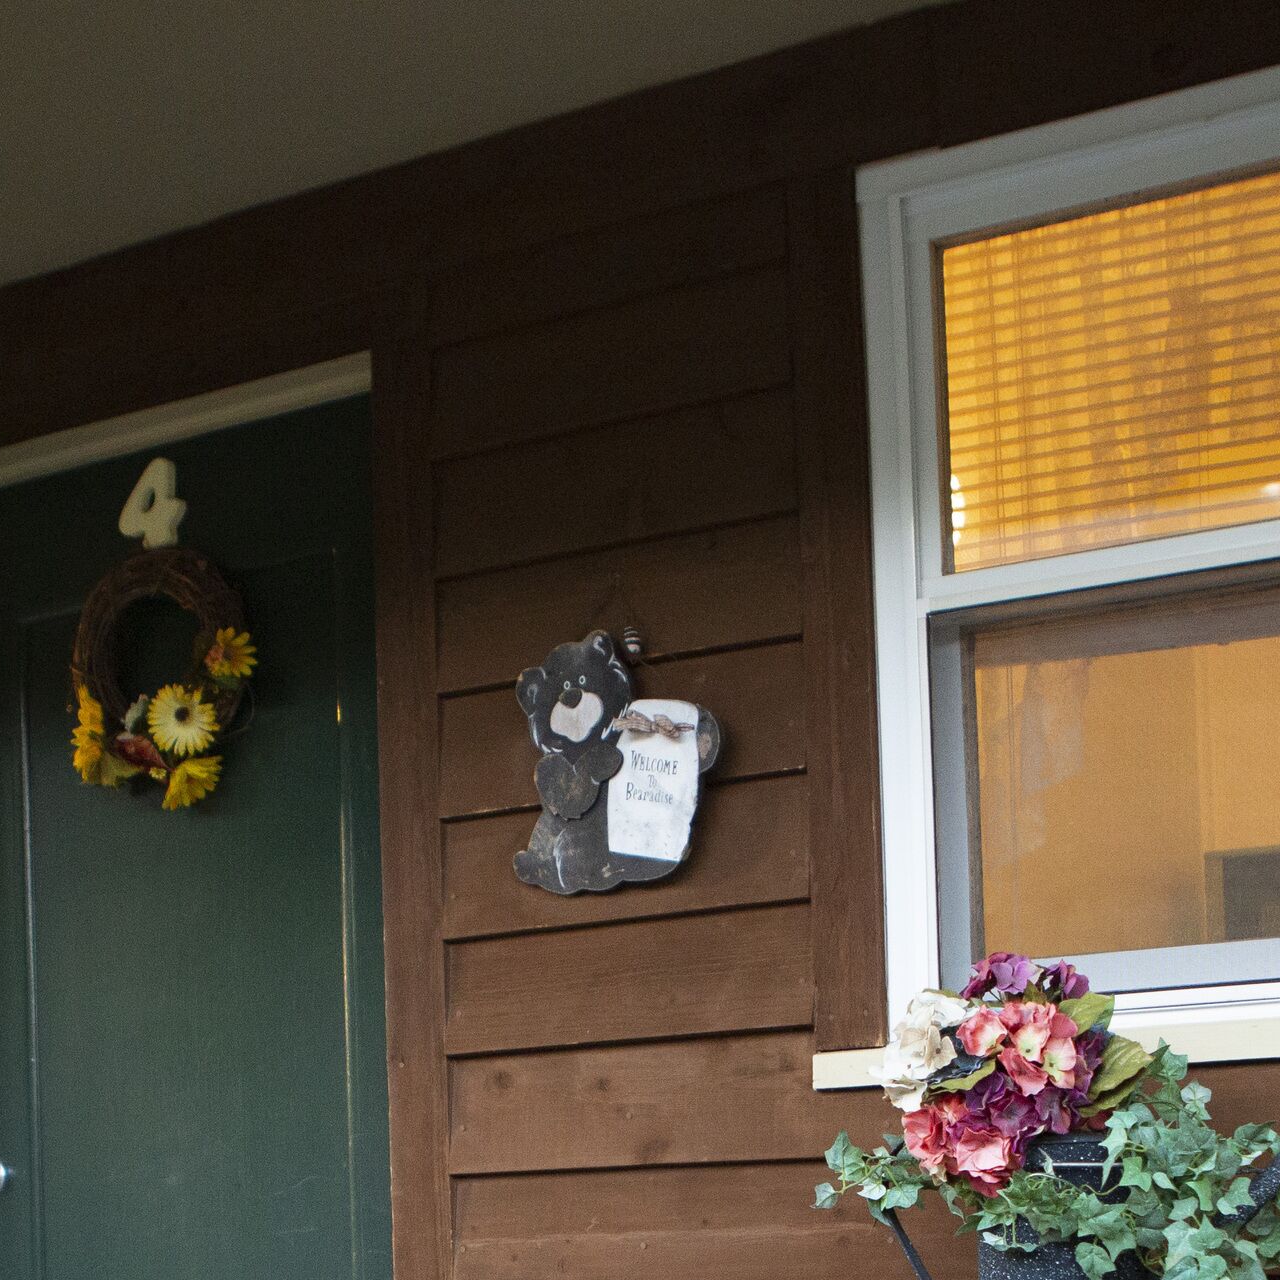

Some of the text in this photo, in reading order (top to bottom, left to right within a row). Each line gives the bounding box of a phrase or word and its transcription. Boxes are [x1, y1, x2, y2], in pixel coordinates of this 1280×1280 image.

[118, 457, 187, 550] 4
[631, 751, 678, 775] WELCOME
[626, 782, 674, 804] Bearadise
